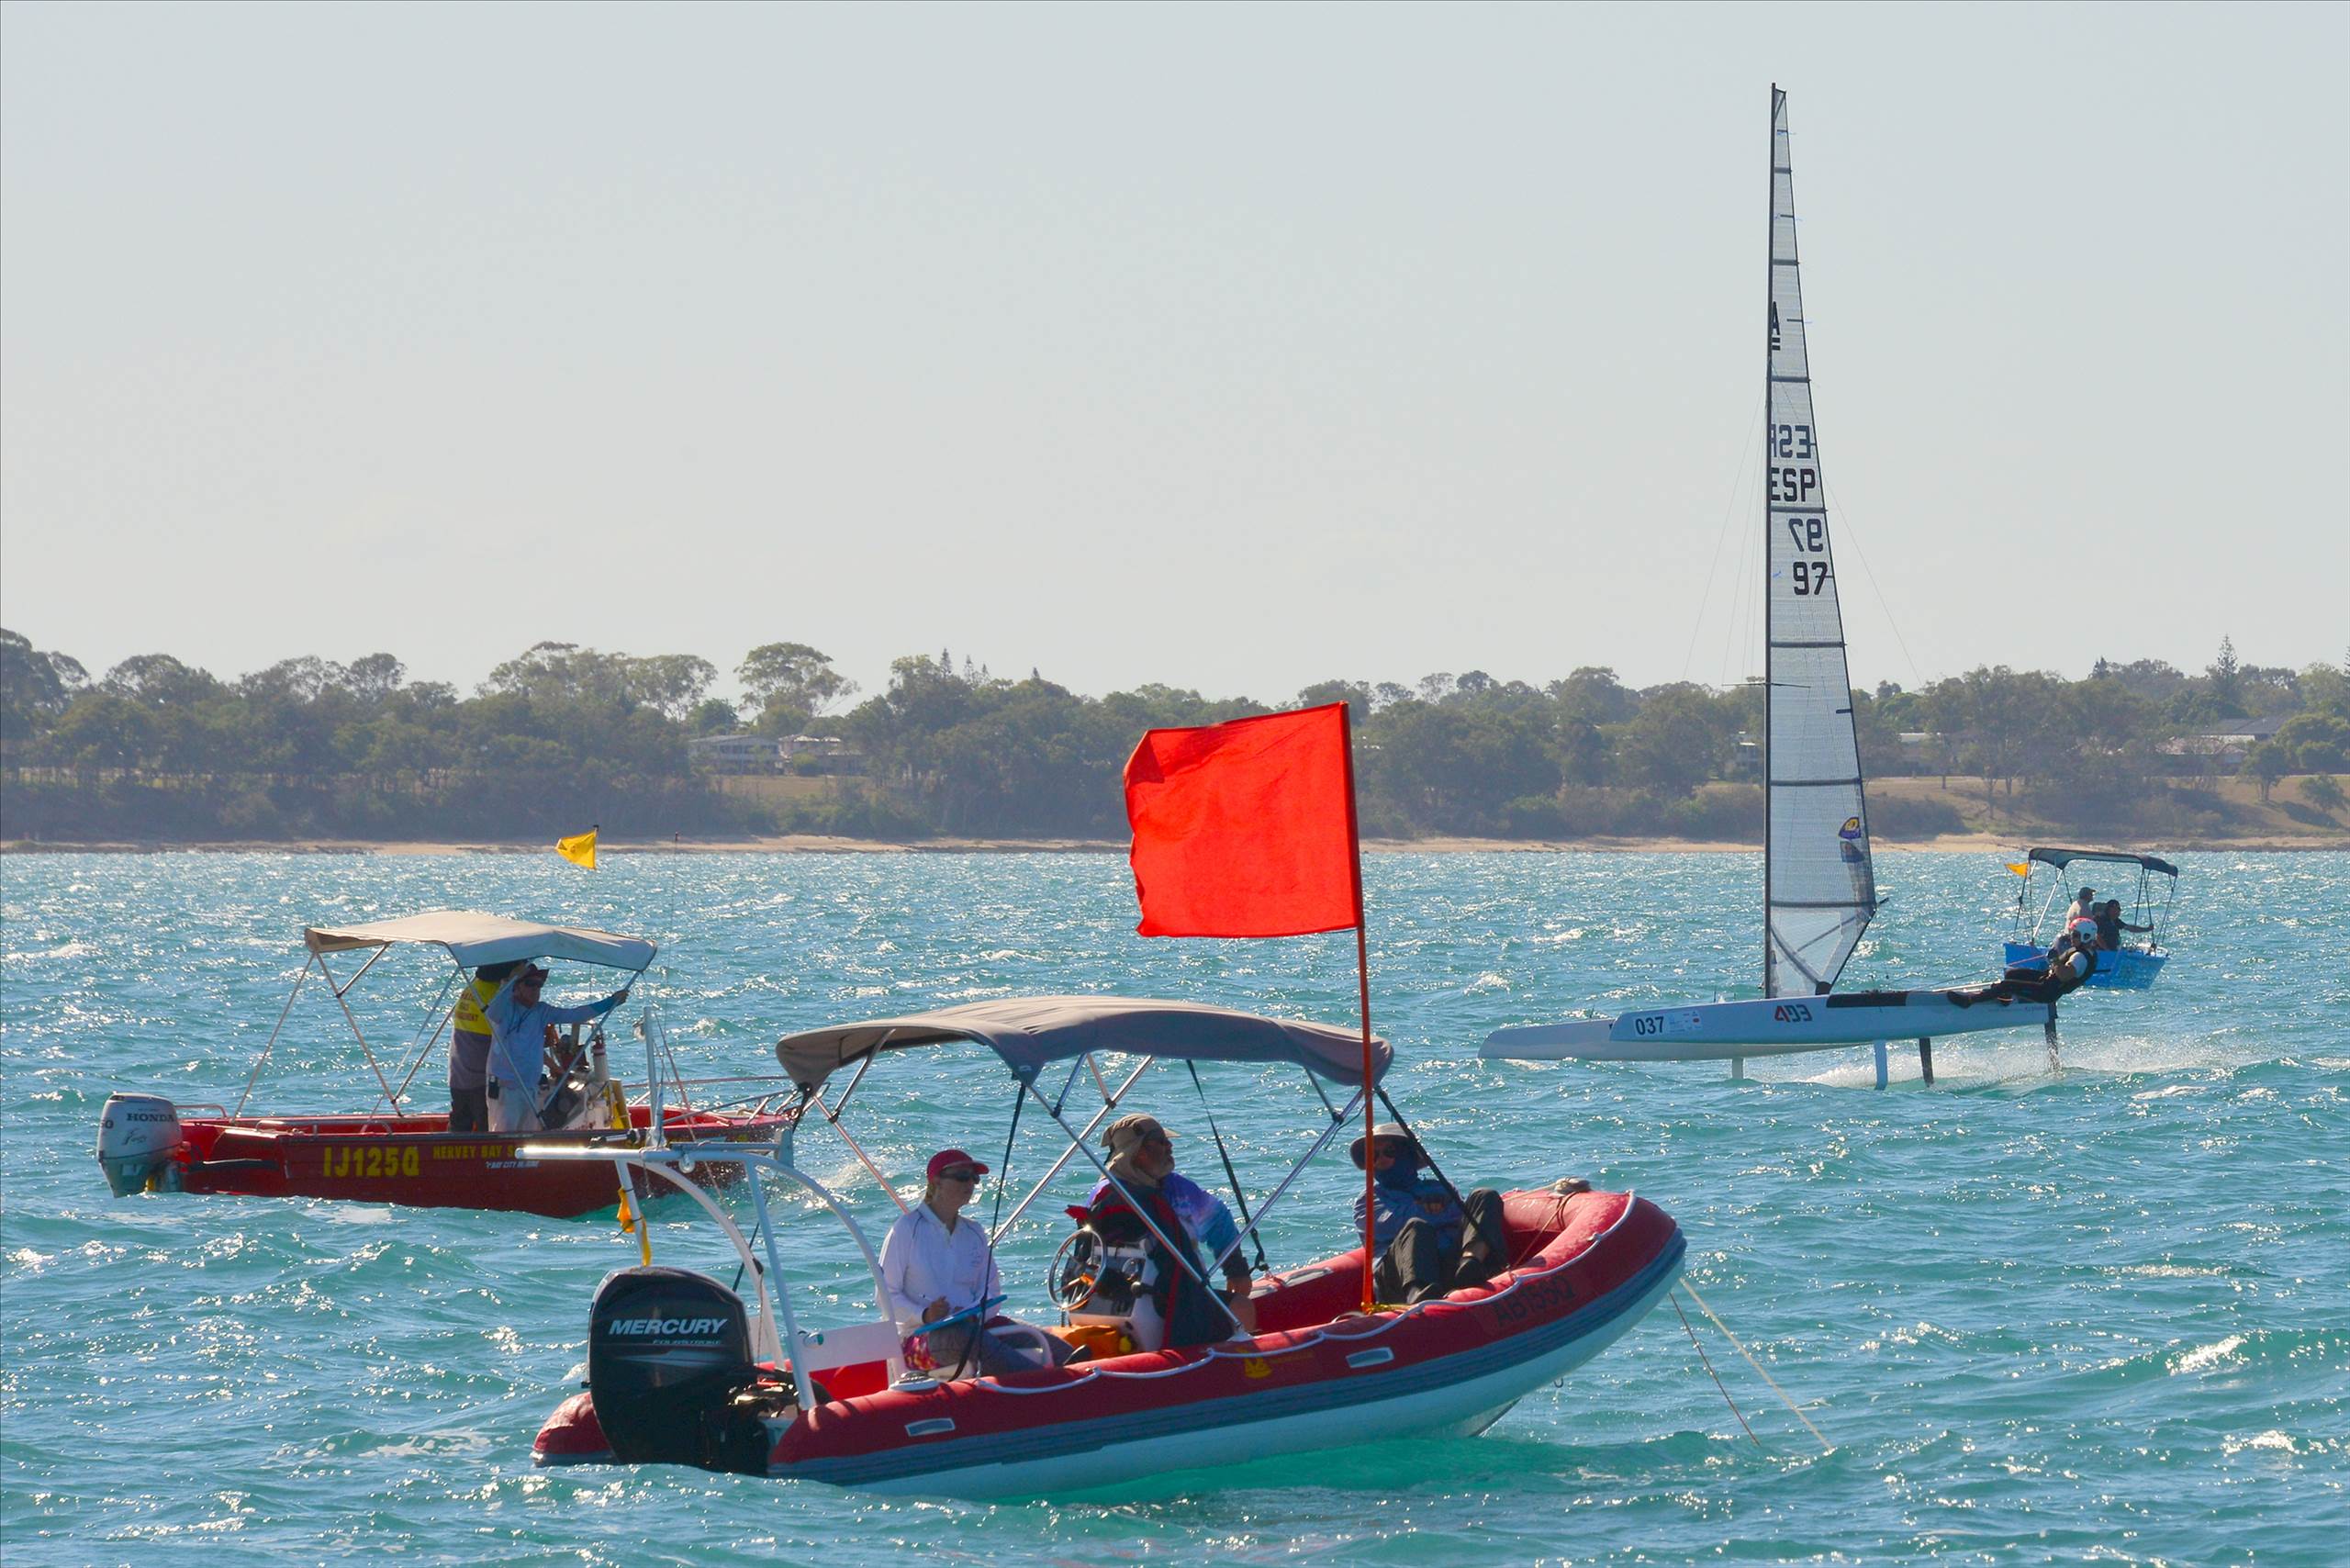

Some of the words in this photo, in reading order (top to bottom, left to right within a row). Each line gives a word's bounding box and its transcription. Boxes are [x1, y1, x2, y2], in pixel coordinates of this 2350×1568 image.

[1771, 467, 1816, 502] ESP
[1793, 561, 1828, 596] 97
[1635, 1015, 1664, 1036] 037
[126, 1113, 174, 1122] HONDA
[323, 1146, 420, 1177] IJ125Q
[432, 1145, 476, 1160] HERVEY
[480, 1145, 503, 1159] BAY
[609, 1318, 727, 1335] MERCURY
